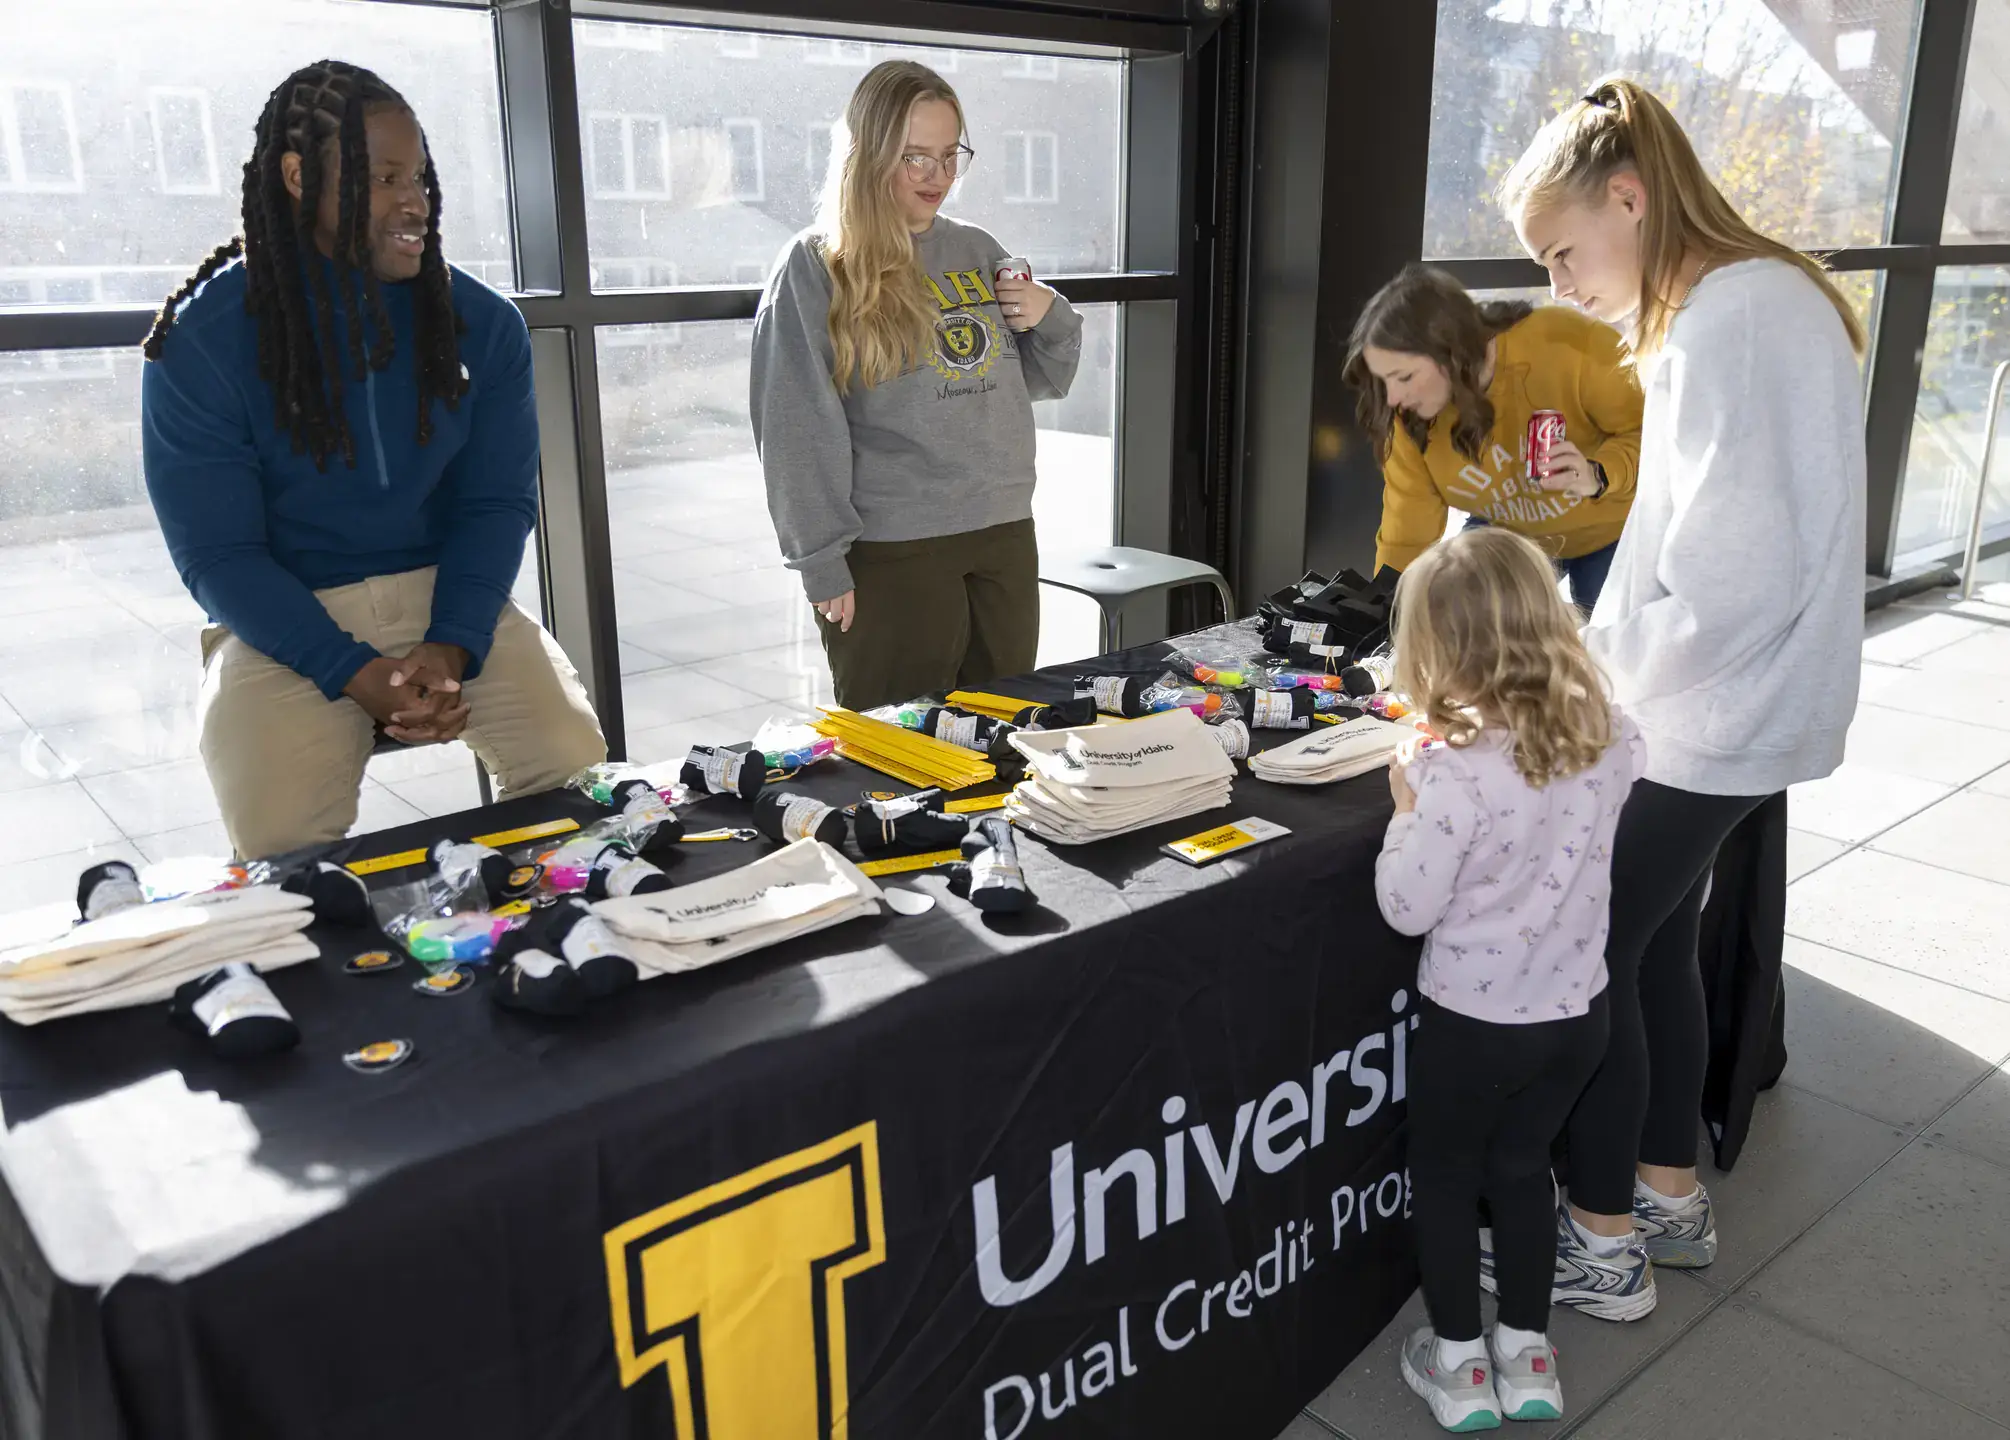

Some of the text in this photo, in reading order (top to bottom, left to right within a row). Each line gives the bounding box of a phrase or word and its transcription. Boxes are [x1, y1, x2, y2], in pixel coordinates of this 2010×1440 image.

[1475, 488, 1583, 523] VANDALS
[1079, 744, 1174, 761] University of Idaho
[676, 898, 747, 917] University
[971, 988, 1420, 1308] Universi
[983, 1307, 1138, 1440] Dual
[1154, 1218, 1315, 1353] Credit
